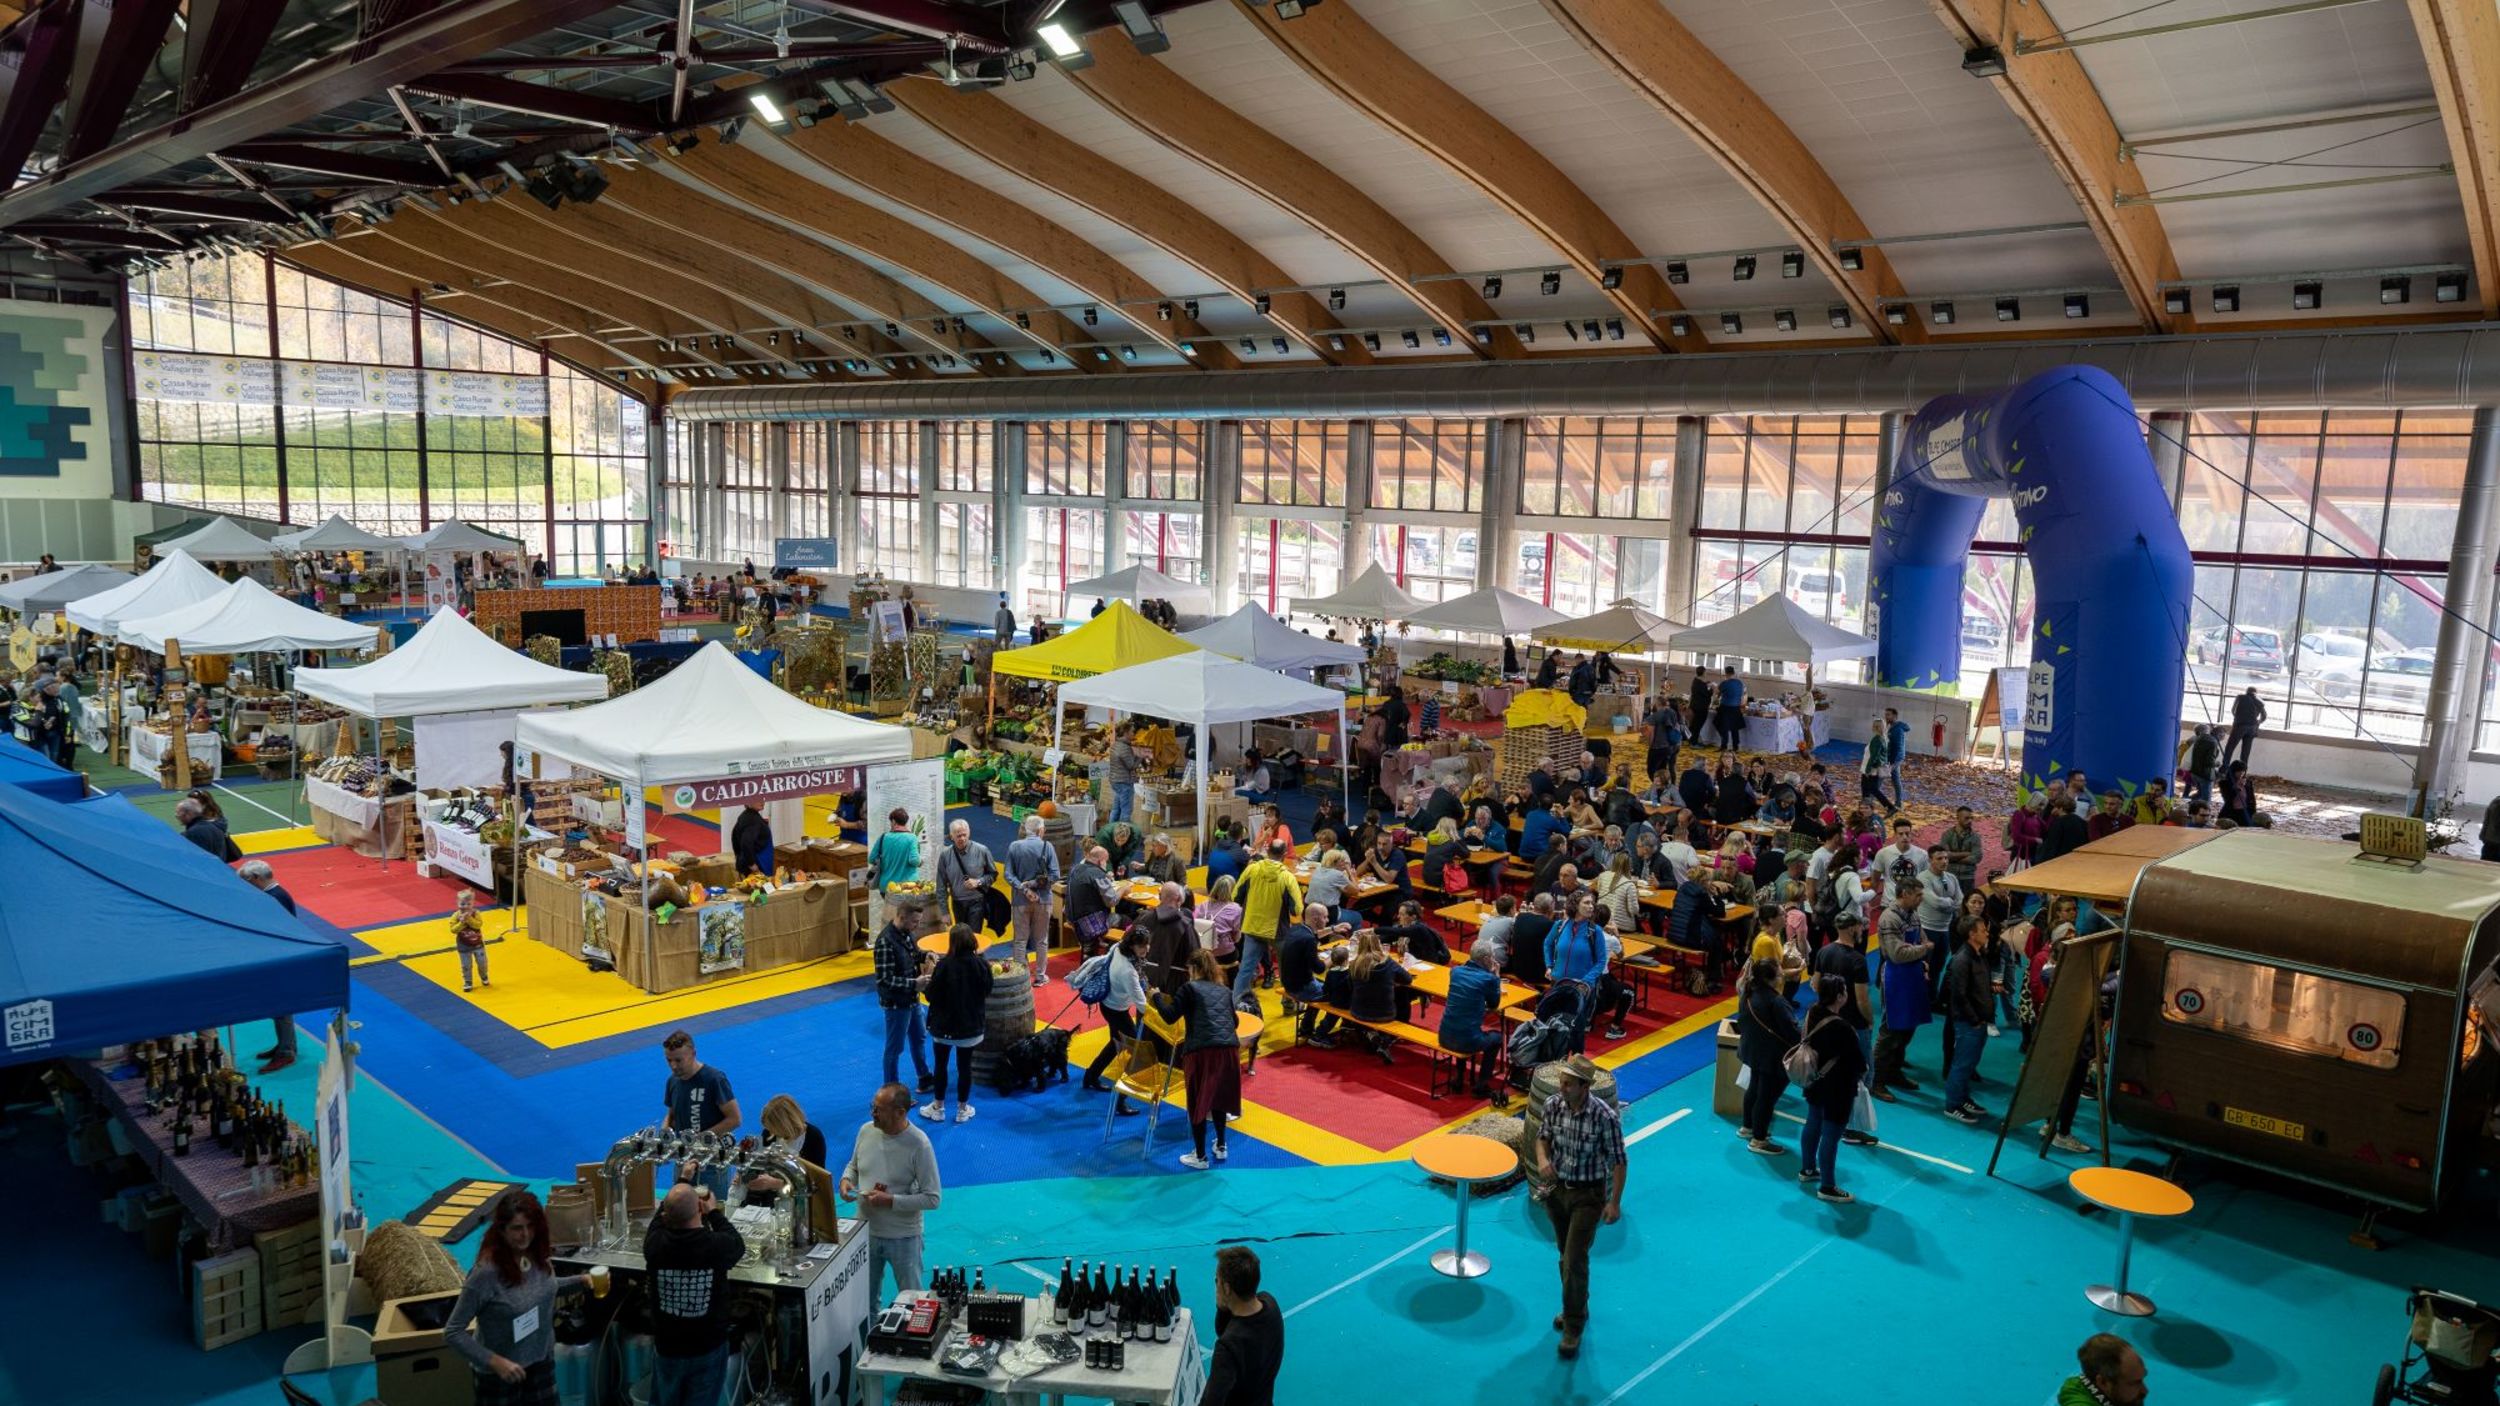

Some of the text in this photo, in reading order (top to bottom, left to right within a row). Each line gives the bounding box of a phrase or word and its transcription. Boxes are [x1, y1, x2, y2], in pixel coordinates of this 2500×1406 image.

[702, 769, 845, 802] CALDARROSTE
[2183, 996, 2197, 1008] 70
[10, 1017, 50, 1031] CIM
[10, 1028, 50, 1042] BRA
[2356, 1031, 2374, 1044] 80
